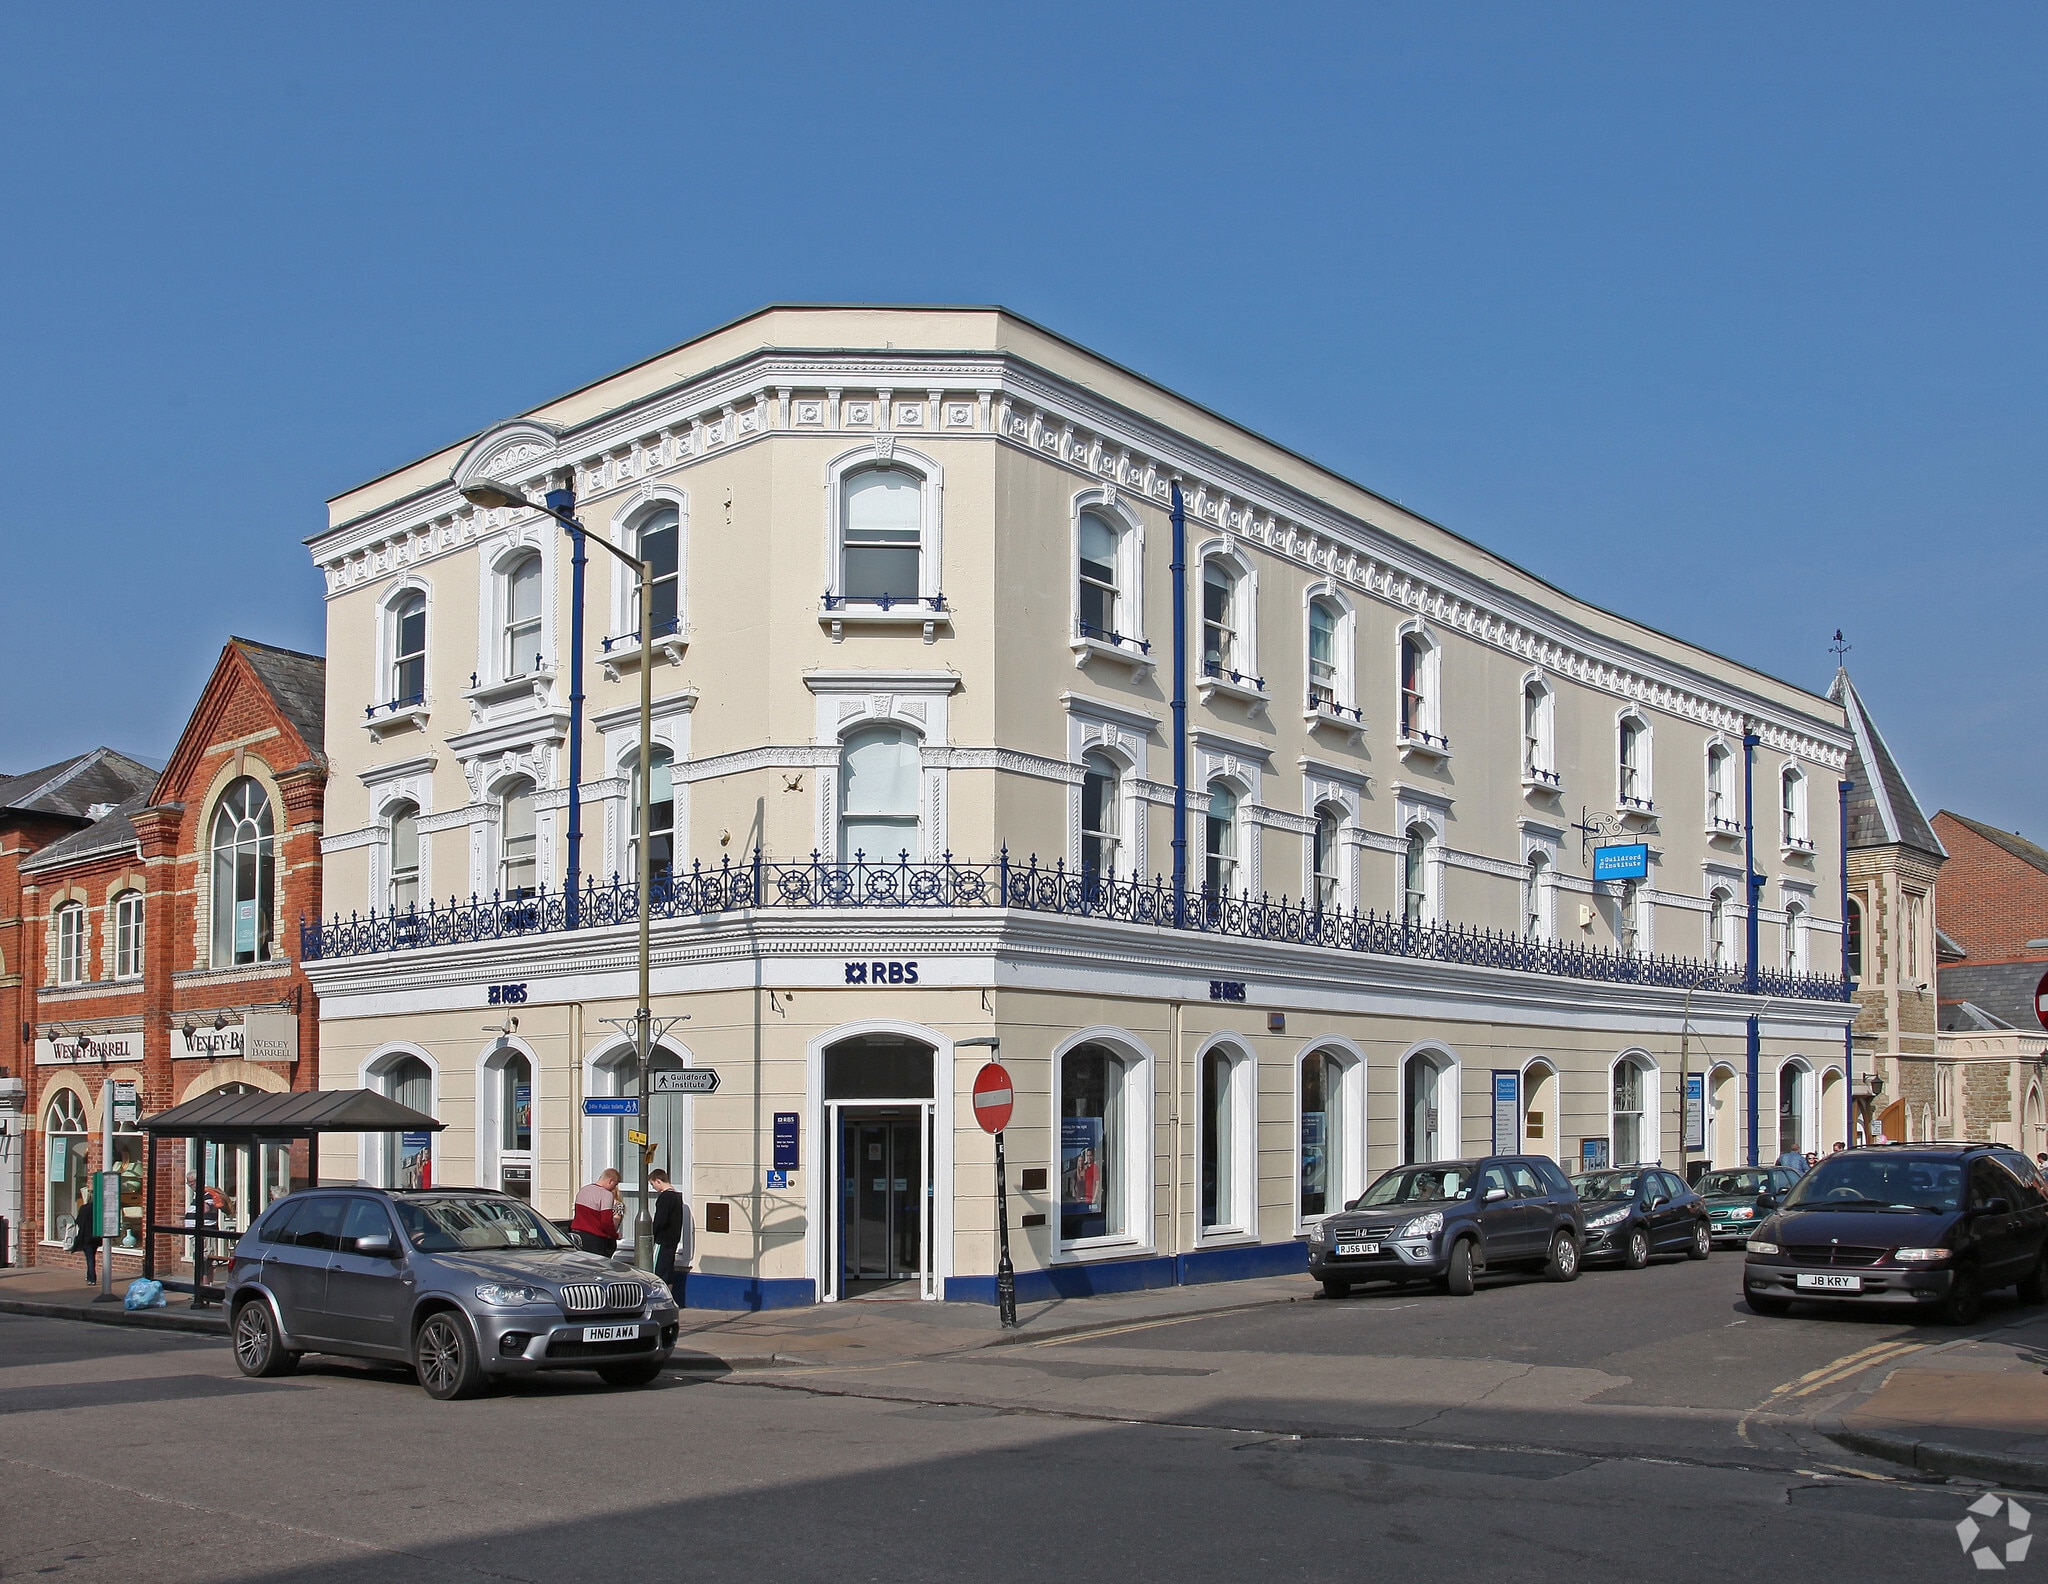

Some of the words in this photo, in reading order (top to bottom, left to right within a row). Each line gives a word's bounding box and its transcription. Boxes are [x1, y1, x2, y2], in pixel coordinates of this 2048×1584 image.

[1605, 854, 1641, 862] Guildford
[1605, 861, 1641, 869] Institute
[872, 962, 919, 984] RBS
[502, 984, 528, 1004] RBS
[1223, 982, 1246, 1001] RBS
[253, 1040, 289, 1048] WESLEY
[1362, 1244, 1377, 1252] UEY
[1811, 1276, 1824, 1285] J8
[1828, 1277, 1849, 1286] KRY
[591, 1328, 613, 1339] HN61
[616, 1327, 633, 1338] AWA
